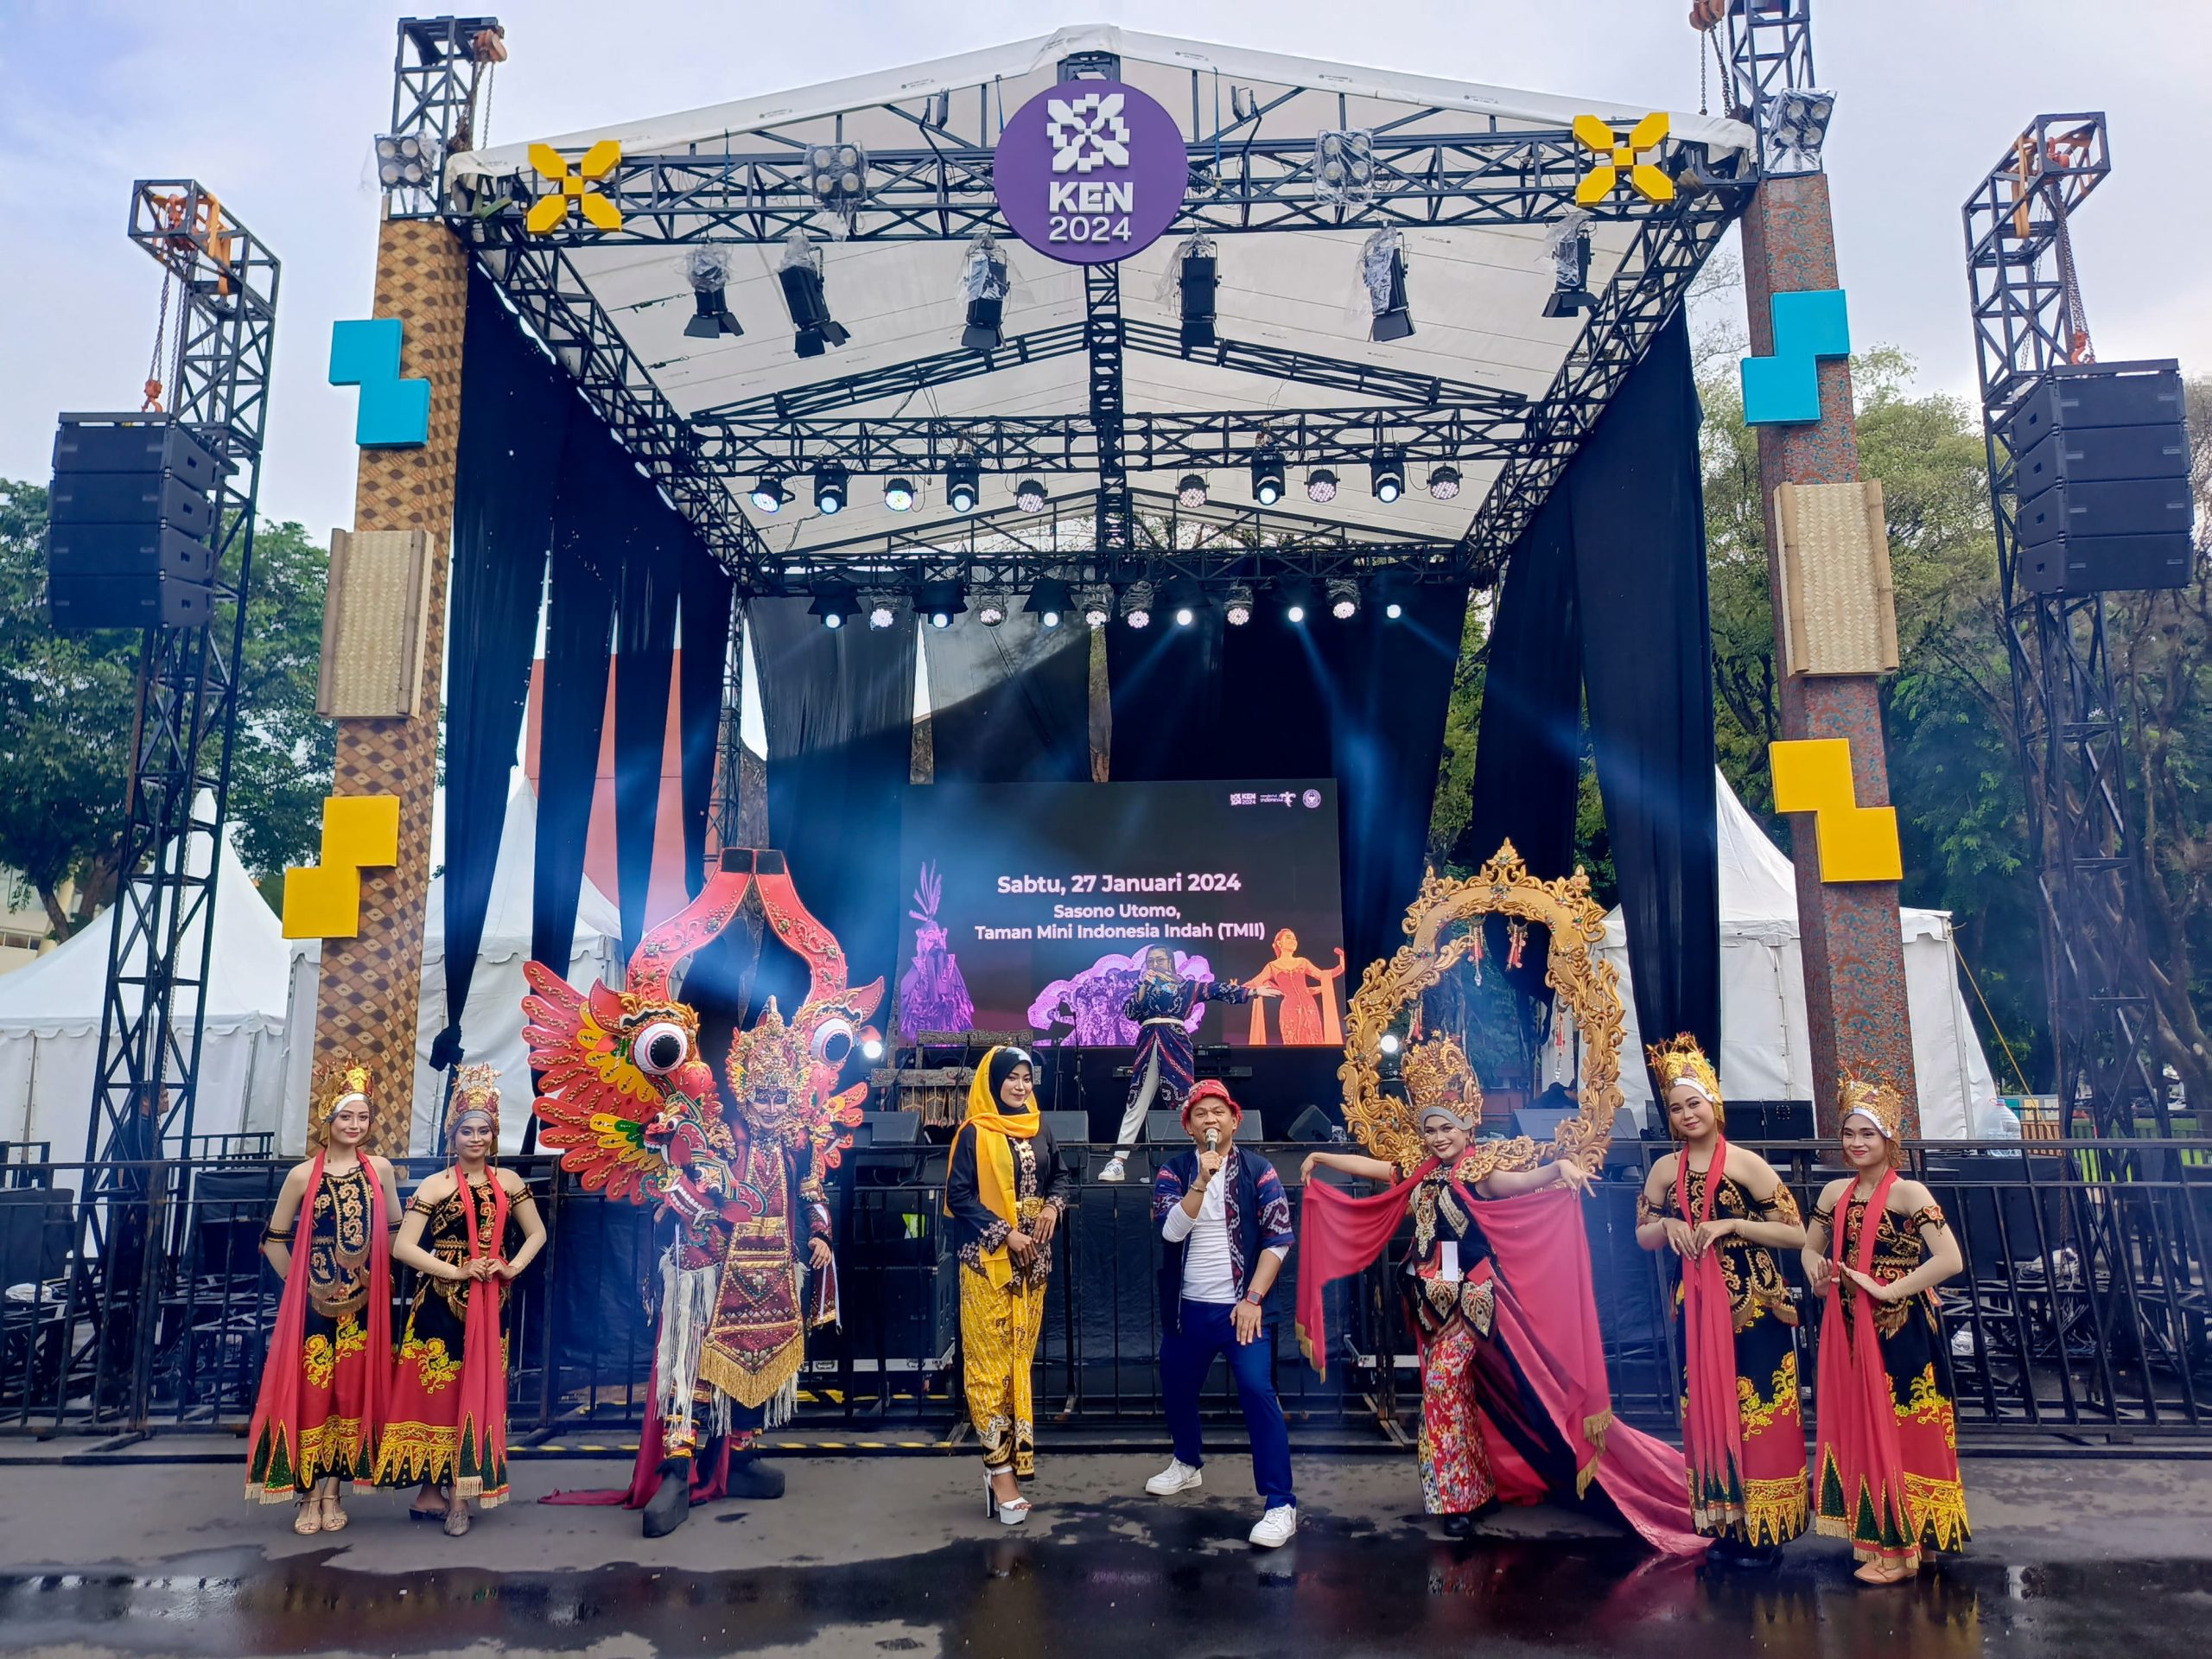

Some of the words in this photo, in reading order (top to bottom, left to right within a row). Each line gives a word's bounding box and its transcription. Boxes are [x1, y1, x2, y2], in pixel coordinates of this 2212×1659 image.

[1049, 181, 1134, 213] KEN
[1049, 216, 1132, 243] 2024
[997, 874, 1066, 896] Sabtu,
[1071, 874, 1097, 893] 27
[1101, 872, 1182, 893] Januari
[1187, 873, 1242, 892] 2024
[1053, 904, 1116, 918] Sasono
[1119, 903, 1181, 920] Utomo,
[975, 925, 1033, 940] Taman
[1037, 923, 1073, 939] Mini
[1077, 922, 1160, 939] Indonesia
[1164, 922, 1213, 938] Indah
[1217, 921, 1266, 941] (TMII)
